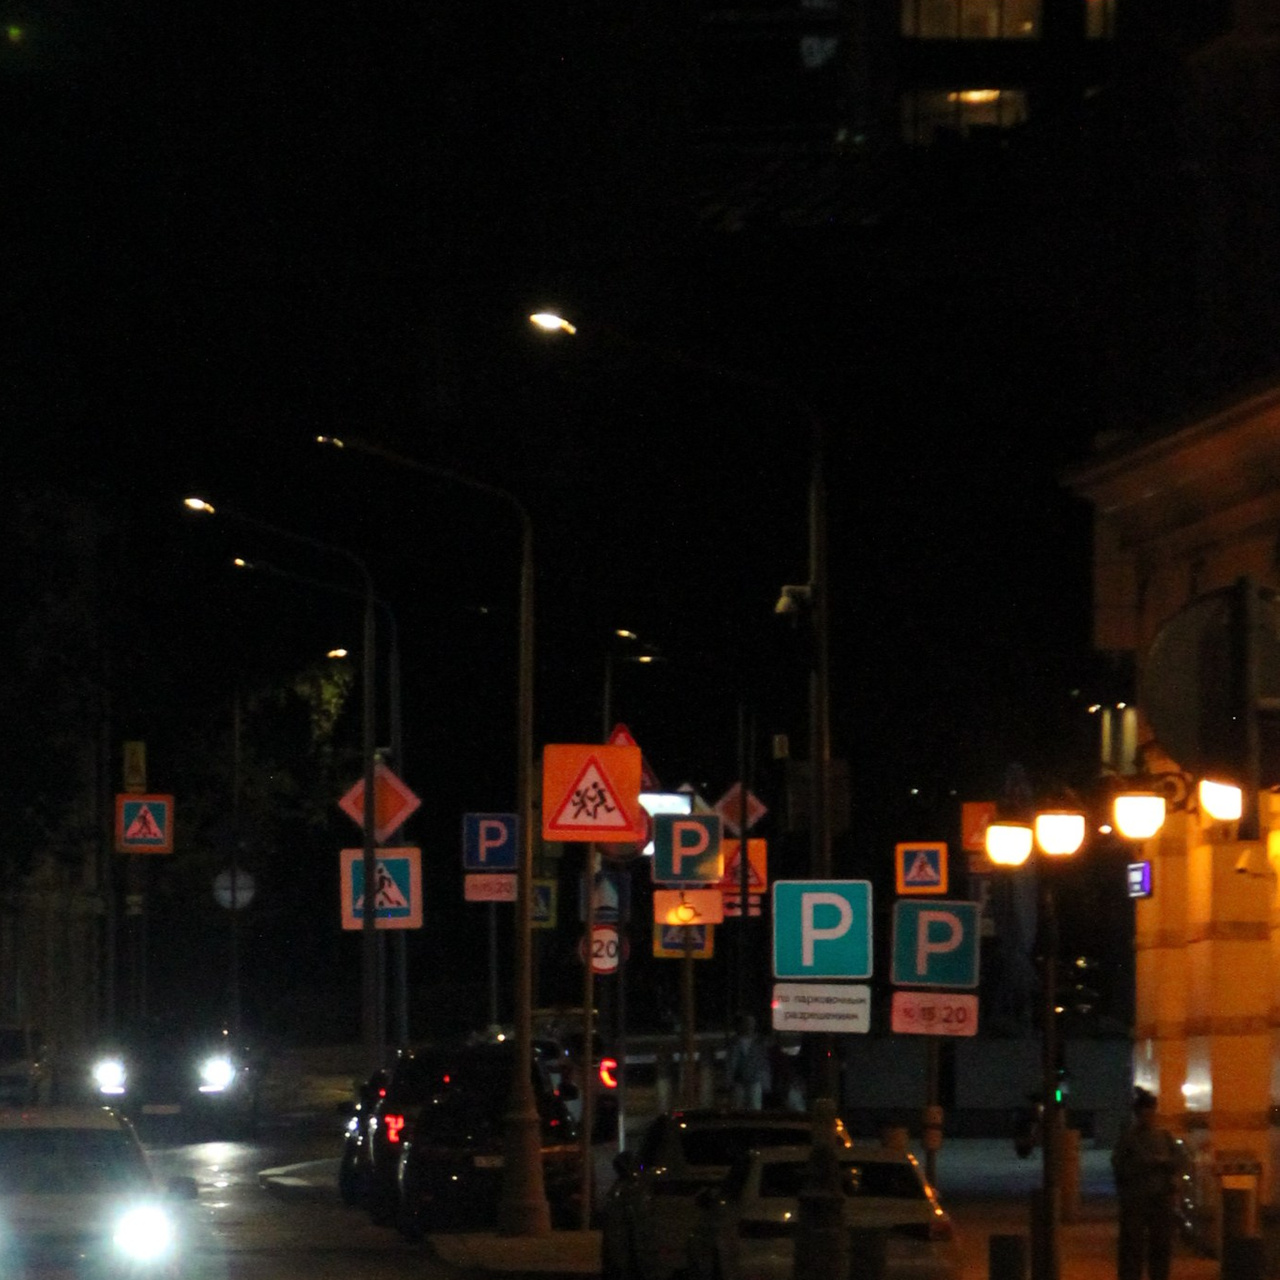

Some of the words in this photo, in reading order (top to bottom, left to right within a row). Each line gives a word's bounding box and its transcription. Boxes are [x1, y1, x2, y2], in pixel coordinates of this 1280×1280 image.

[479, 820, 507, 861] P
[672, 821, 709, 875] P
[592, 940, 618, 958] 20
[801, 892, 853, 966] P
[916, 910, 963, 975] P
[942, 1006, 967, 1024] 20
